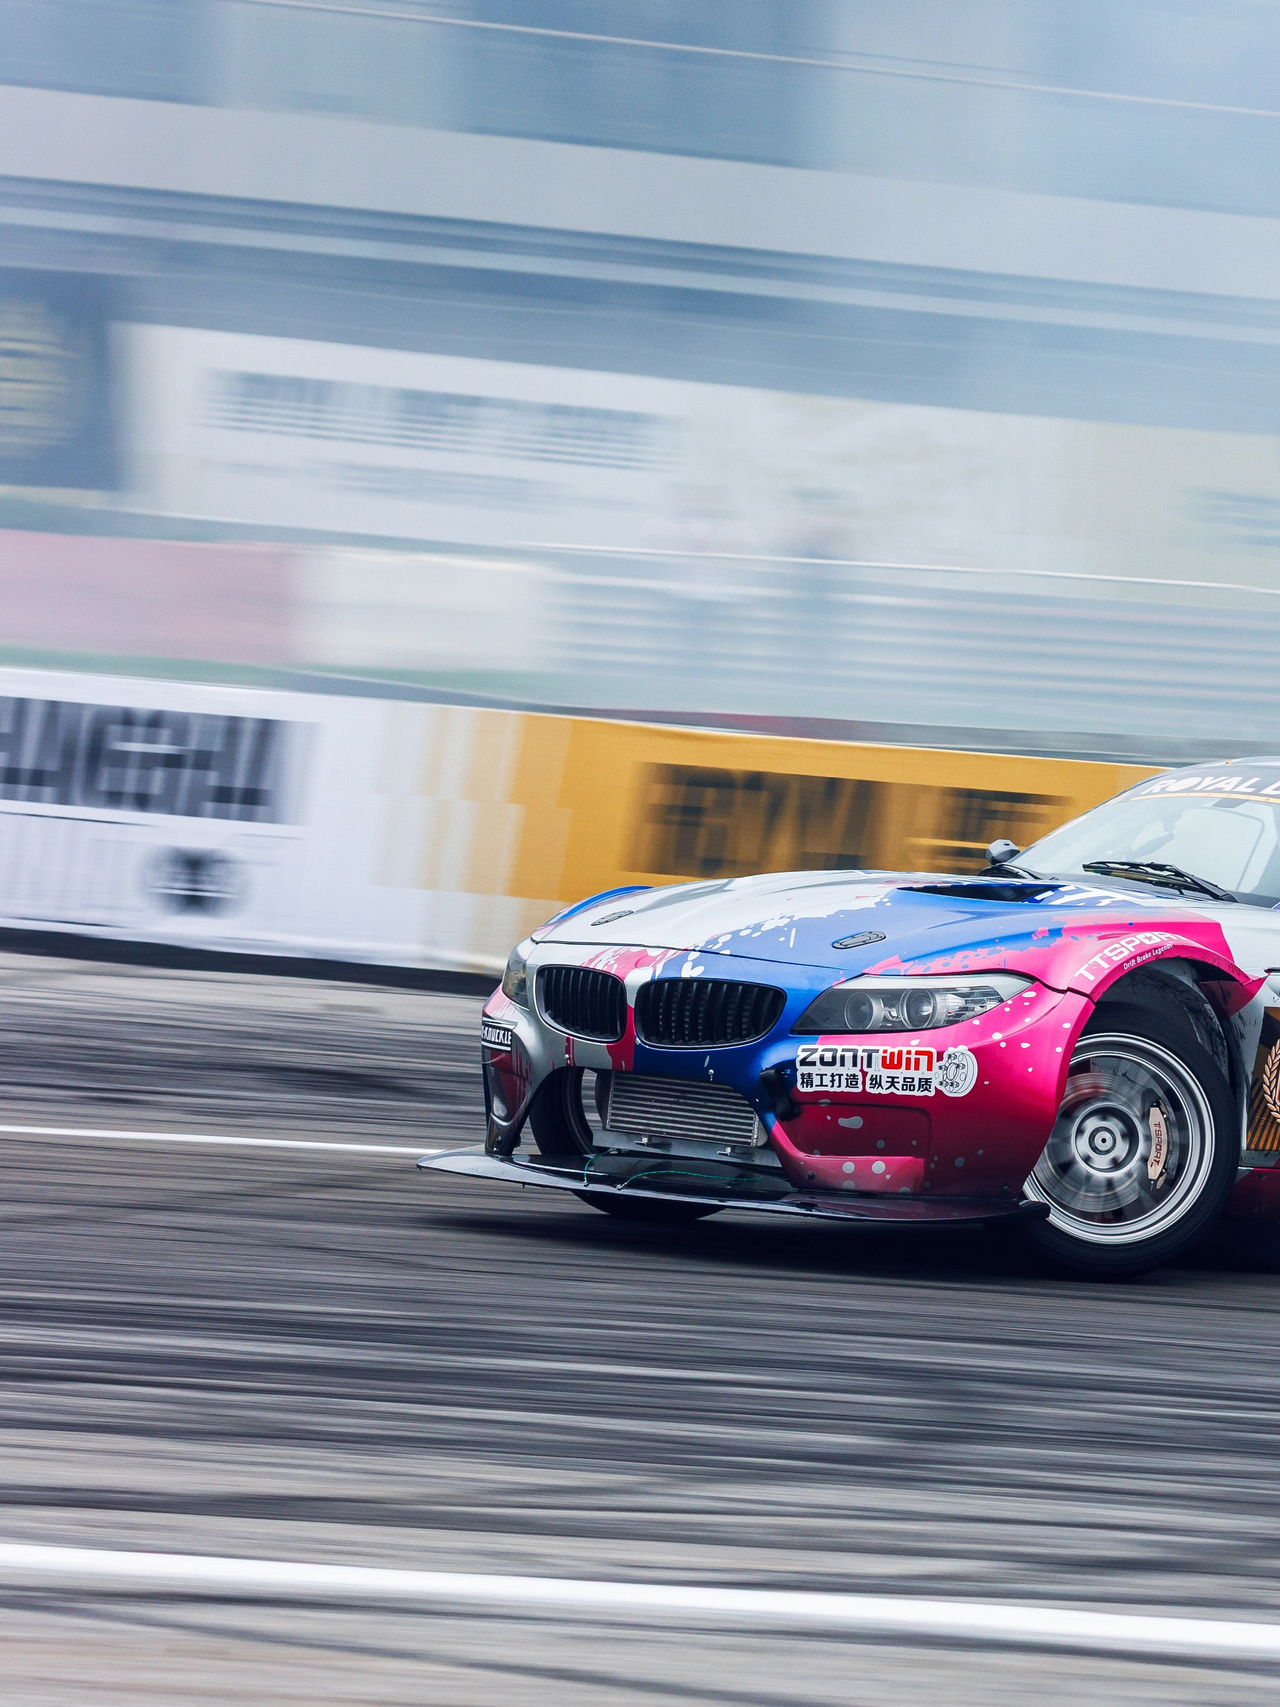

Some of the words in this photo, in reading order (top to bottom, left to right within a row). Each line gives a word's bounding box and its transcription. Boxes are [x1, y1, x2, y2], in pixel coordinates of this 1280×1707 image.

[1139, 776, 1257, 796] ROYAL
[1073, 931, 1187, 982] TTSPORT
[1123, 958, 1136, 971] Drift
[1136, 952, 1152, 963] Brake
[800, 1072, 860, 1089] 精工打造
[868, 1073, 933, 1093] 纵天品质
